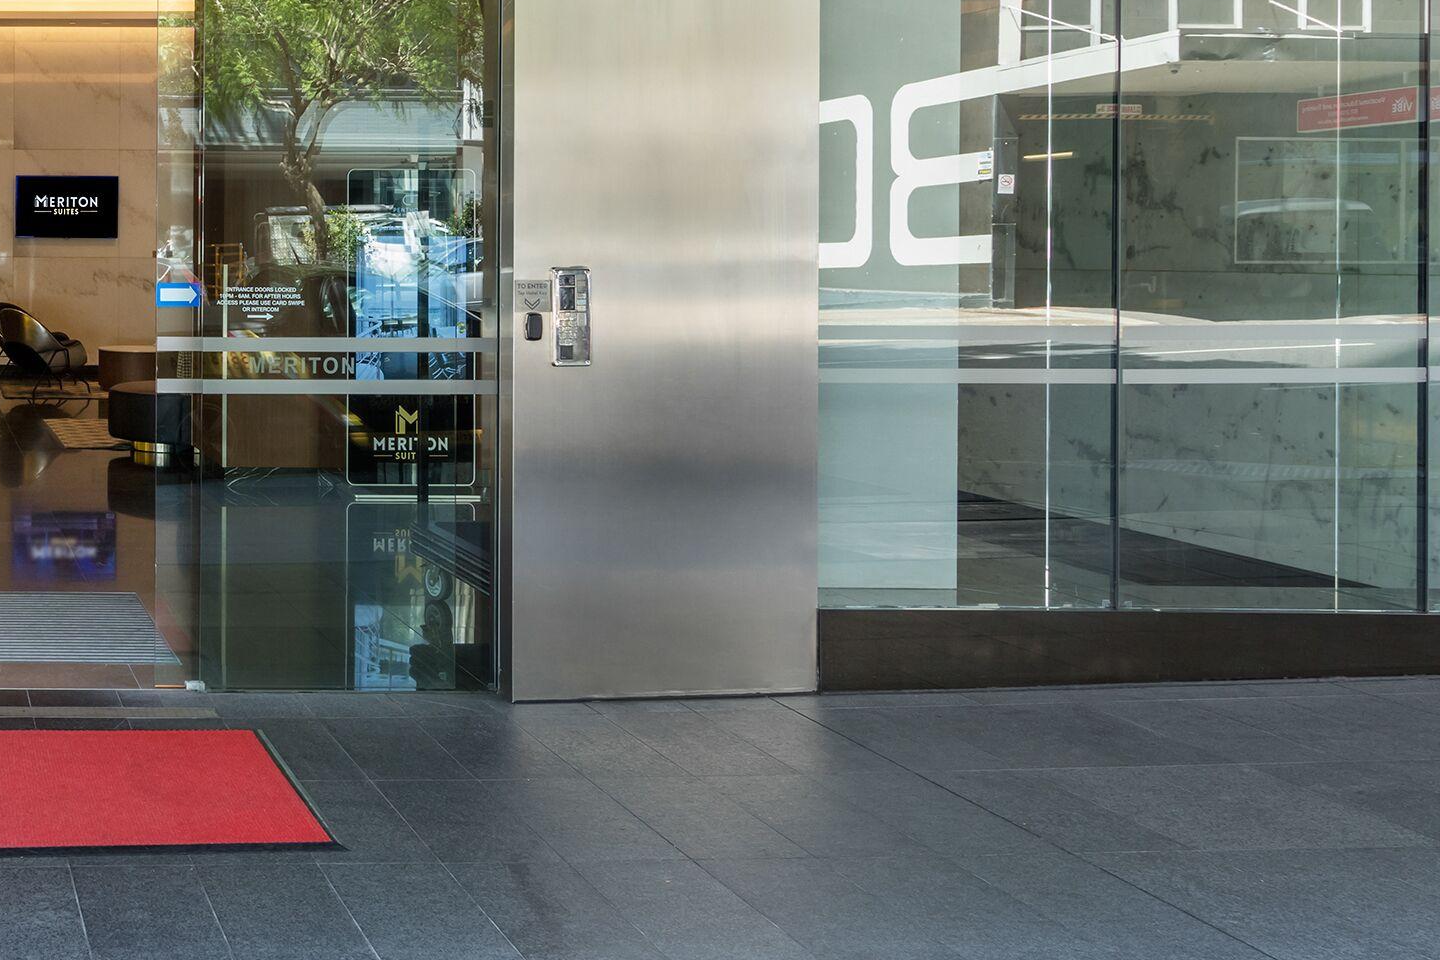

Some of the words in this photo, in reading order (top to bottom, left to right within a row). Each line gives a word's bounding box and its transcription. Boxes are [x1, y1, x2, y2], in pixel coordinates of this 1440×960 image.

[34, 195, 98, 208] MERITON
[249, 356, 355, 375] MERITON
[395, 452, 417, 460] SUIT
